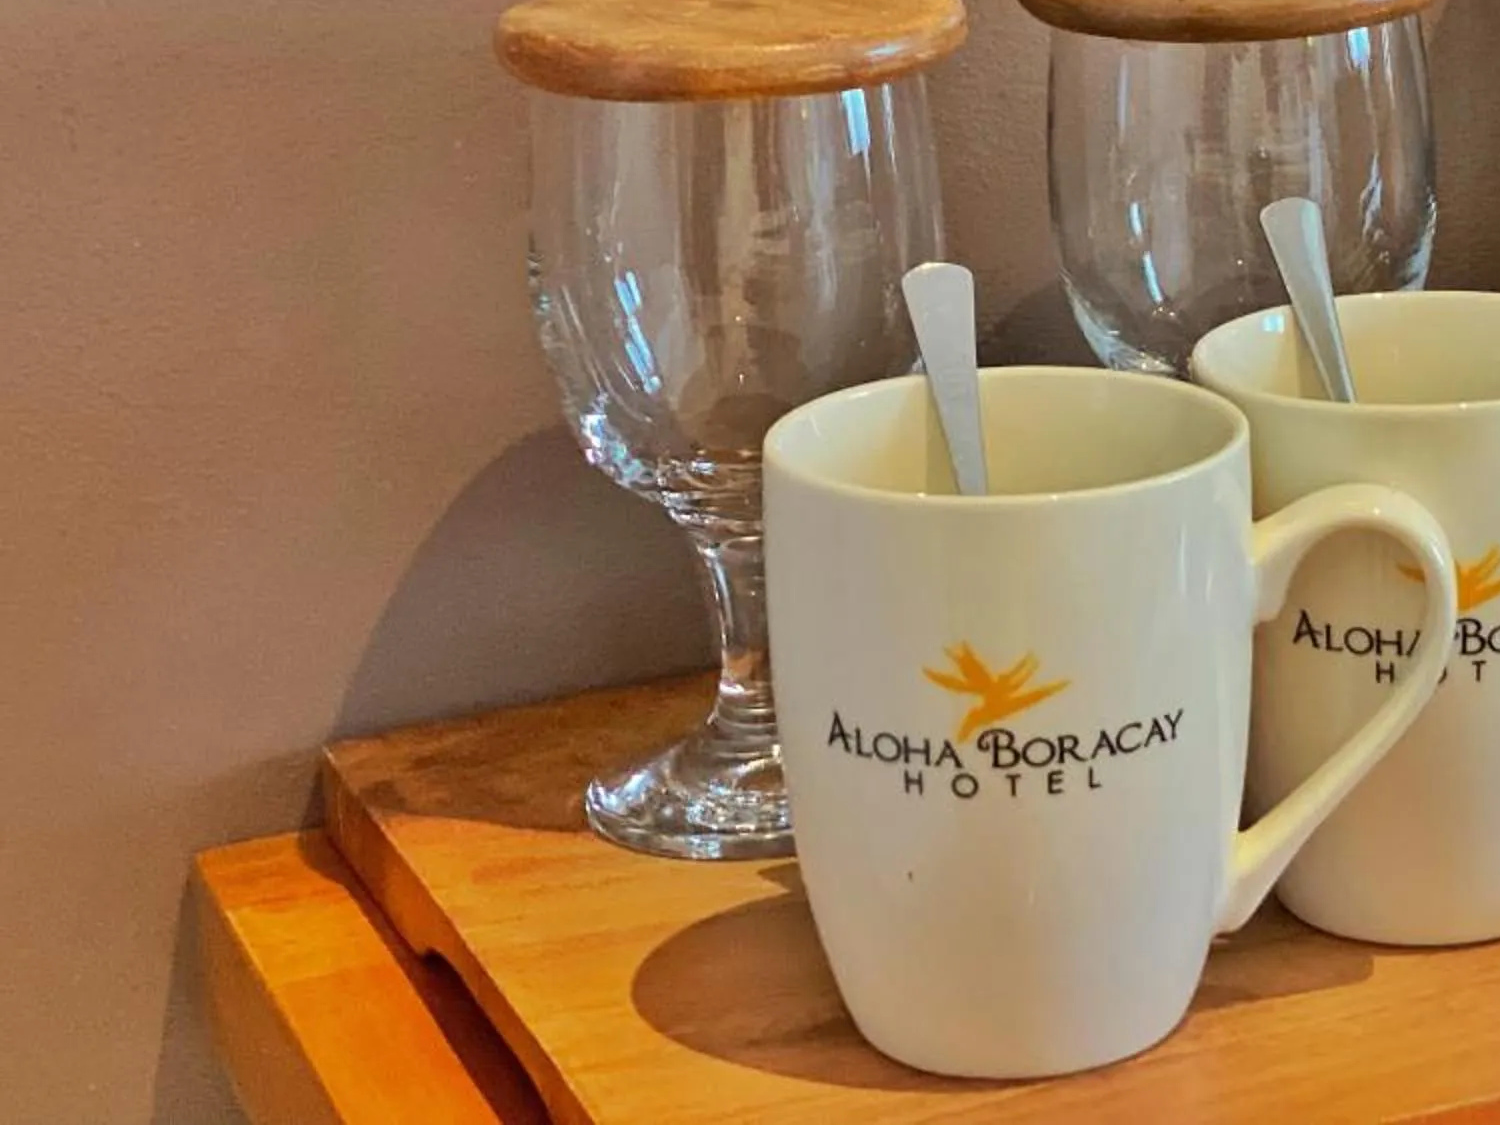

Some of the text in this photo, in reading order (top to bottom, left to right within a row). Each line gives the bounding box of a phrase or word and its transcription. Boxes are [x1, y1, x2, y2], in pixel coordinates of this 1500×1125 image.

[827, 708, 1184, 769] ALOHA BORACAY
[904, 768, 1103, 799] HOTEL
